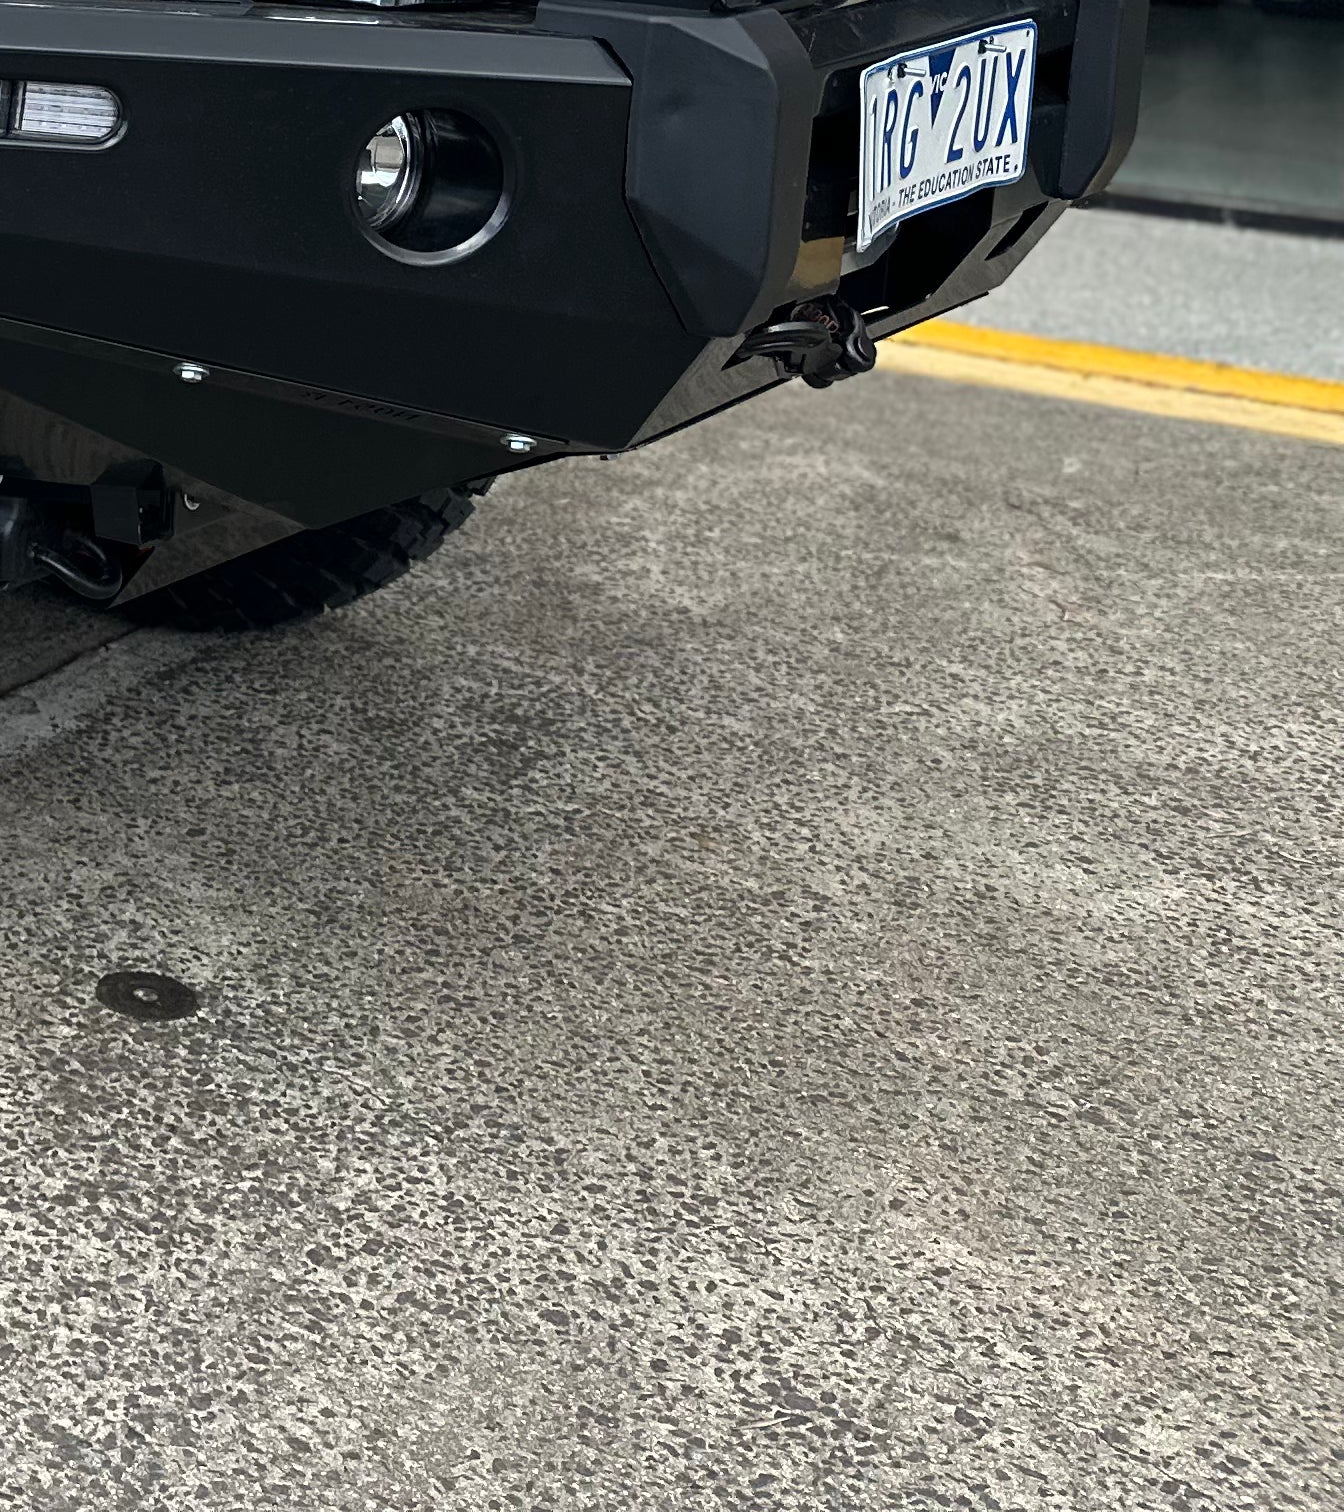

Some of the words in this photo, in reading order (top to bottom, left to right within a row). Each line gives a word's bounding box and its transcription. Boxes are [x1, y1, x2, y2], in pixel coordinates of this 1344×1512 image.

[944, 47, 1027, 165] 2UX
[898, 184, 917, 209] THE
[917, 165, 974, 200] EDUCATION
[975, 154, 1011, 180] STATE
